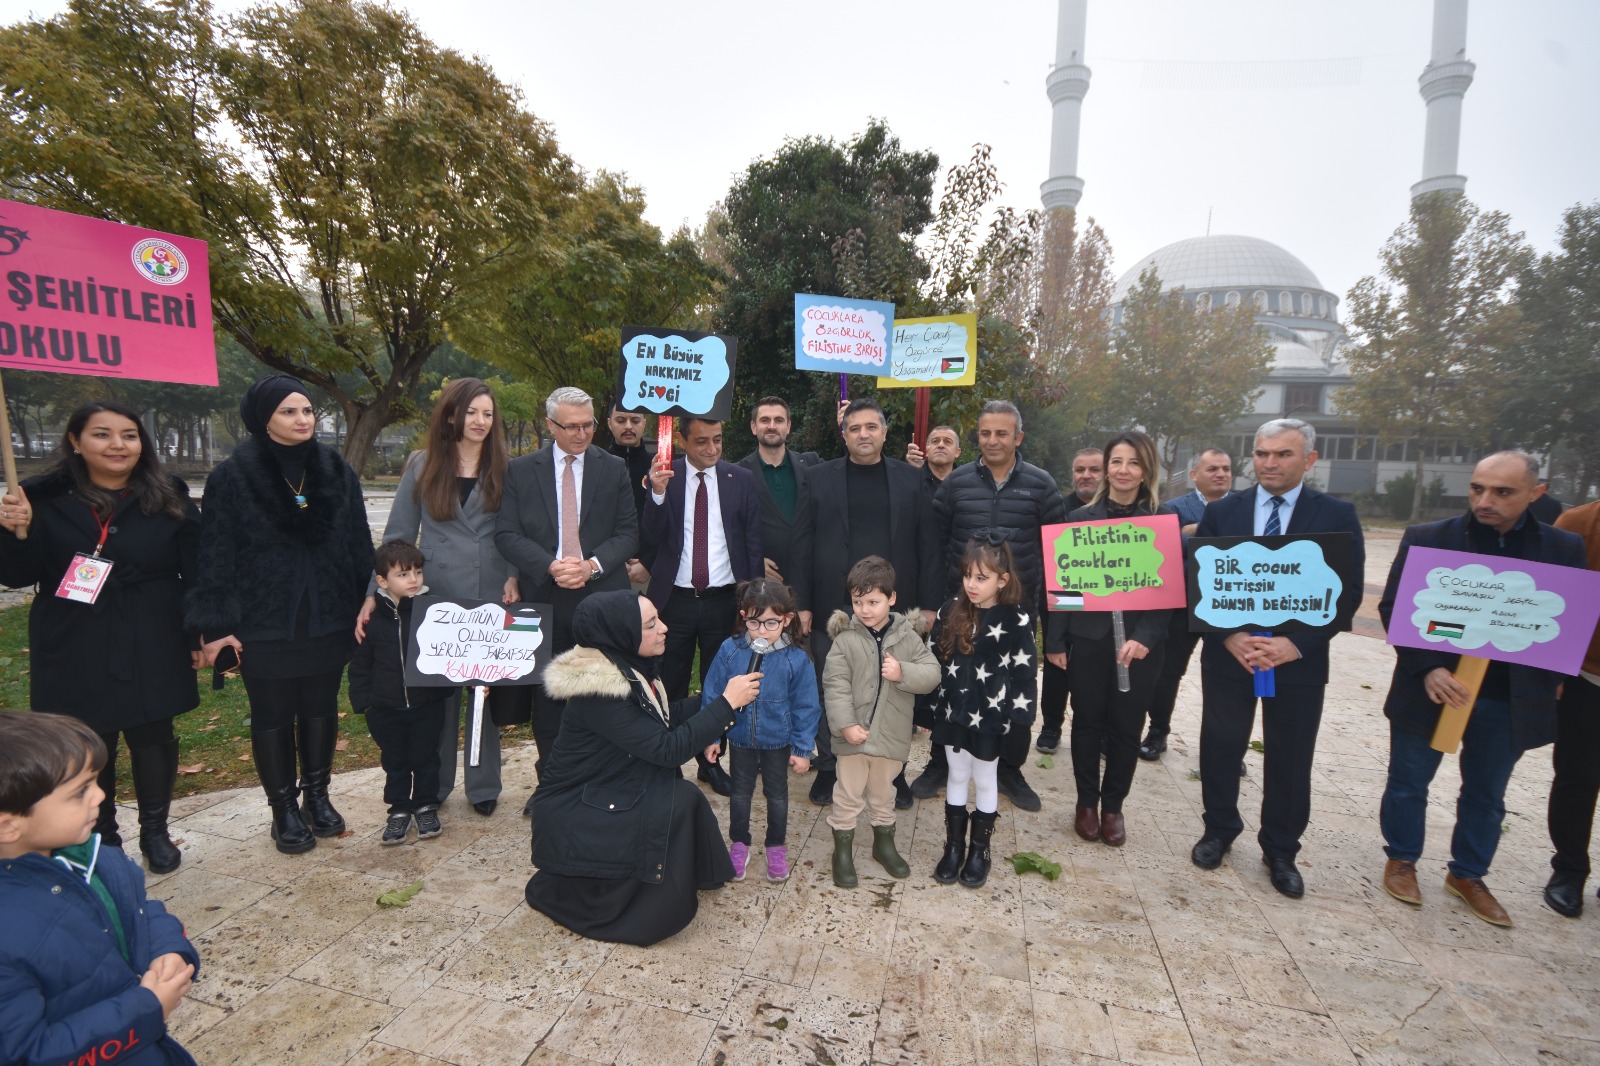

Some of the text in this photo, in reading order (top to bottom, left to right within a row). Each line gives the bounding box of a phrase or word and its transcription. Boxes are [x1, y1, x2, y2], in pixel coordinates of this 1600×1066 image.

[7, 270, 197, 329] ŞEHİTLERİ
[807, 308, 865, 324] ÇOCUKLARA
[895, 328, 919, 344] Her
[807, 339, 883, 363] FİLİSTİNE BARIŞ!
[645, 365, 702, 382] HAKKIMIZ
[1057, 550, 1131, 573] Çocukları
[1214, 554, 1302, 577] BİR ÇOCUK
[1061, 575, 1099, 590] Yalnız
[1213, 577, 1276, 594] YETİŞSİN
[1211, 588, 1333, 619] DÜNYA DEĞİŞSİN!
[433, 608, 500, 627] ZULMÜN
[458, 627, 511, 644] OLDUĞU
[426, 641, 472, 658] YERDE
[61, 1028, 140, 1066] TOM
